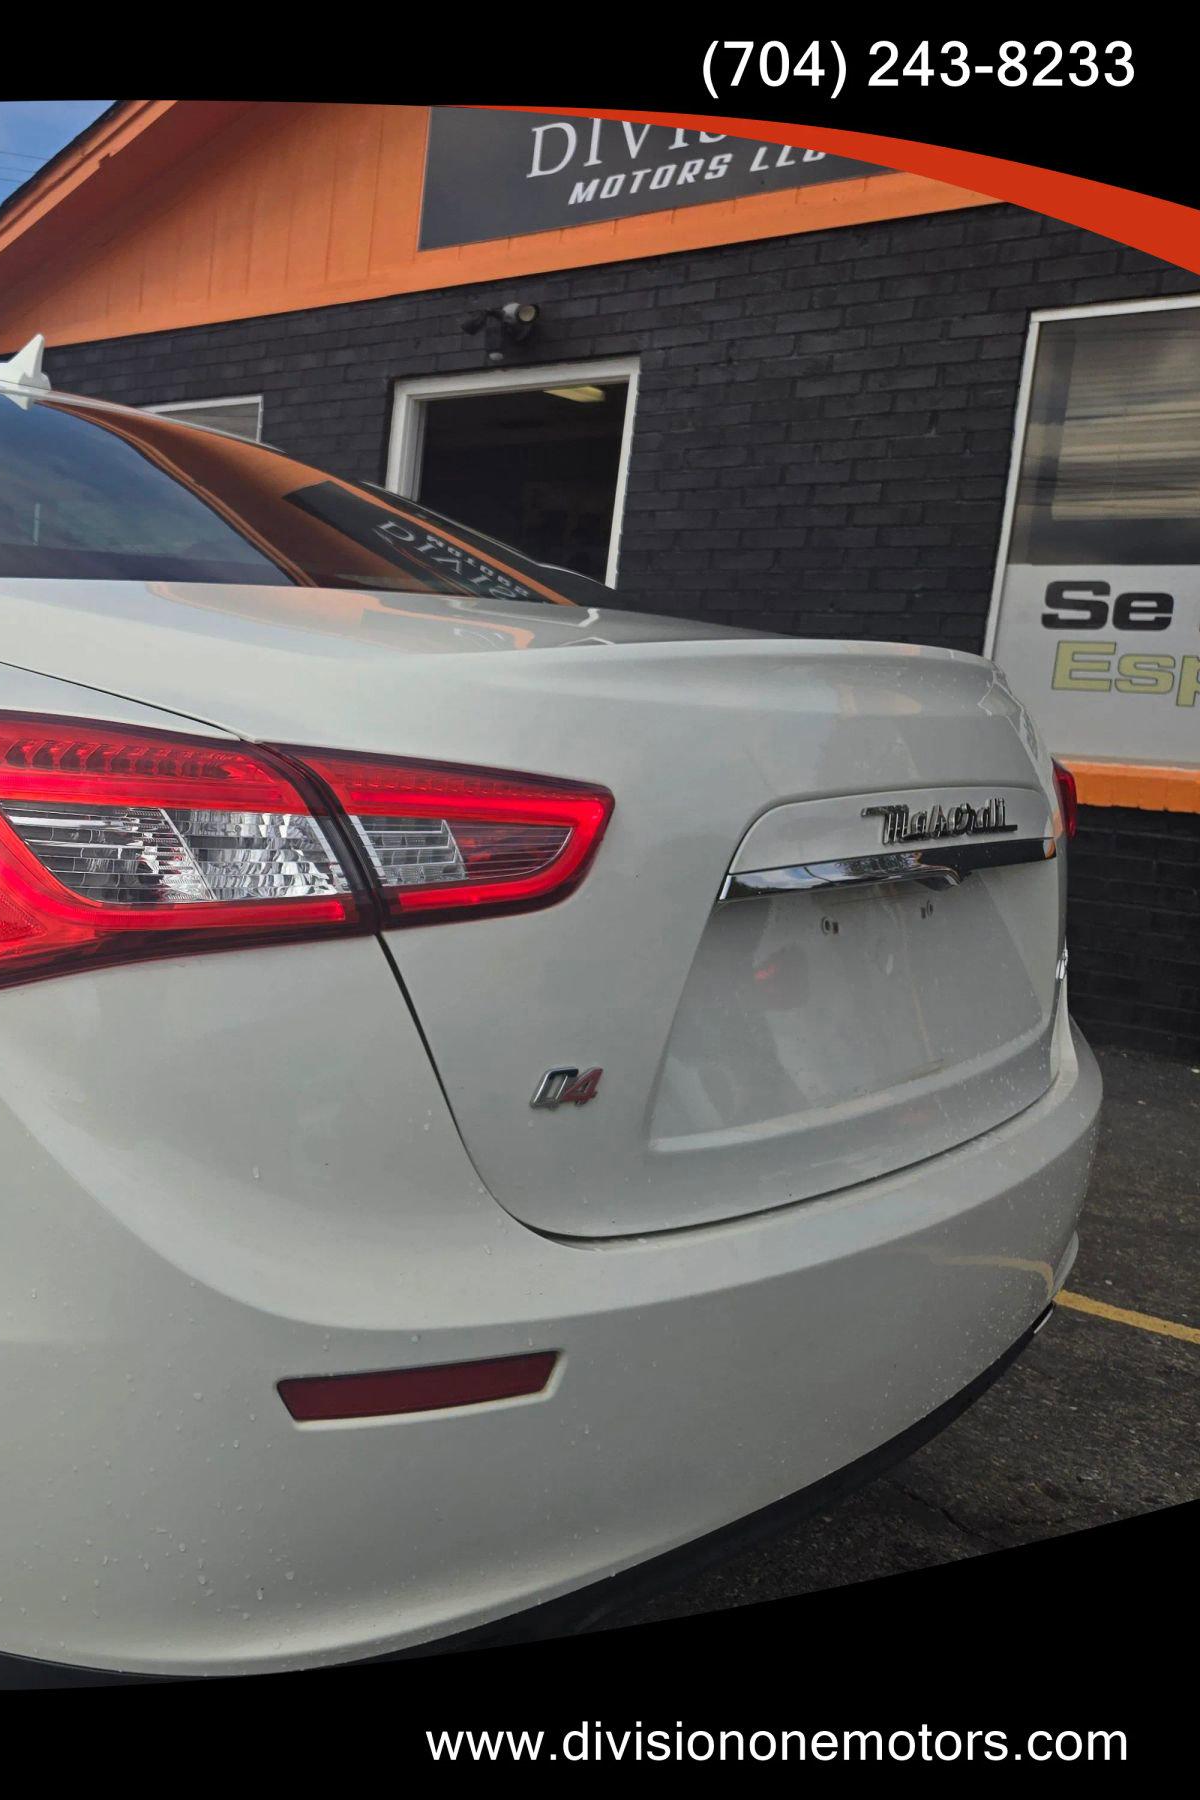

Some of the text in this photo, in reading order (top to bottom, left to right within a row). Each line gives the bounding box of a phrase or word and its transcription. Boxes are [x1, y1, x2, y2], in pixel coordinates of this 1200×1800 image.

[568, 153, 733, 205] MOTORS
[1041, 580, 1175, 631] Se
[529, 1066, 604, 1111] Q4
